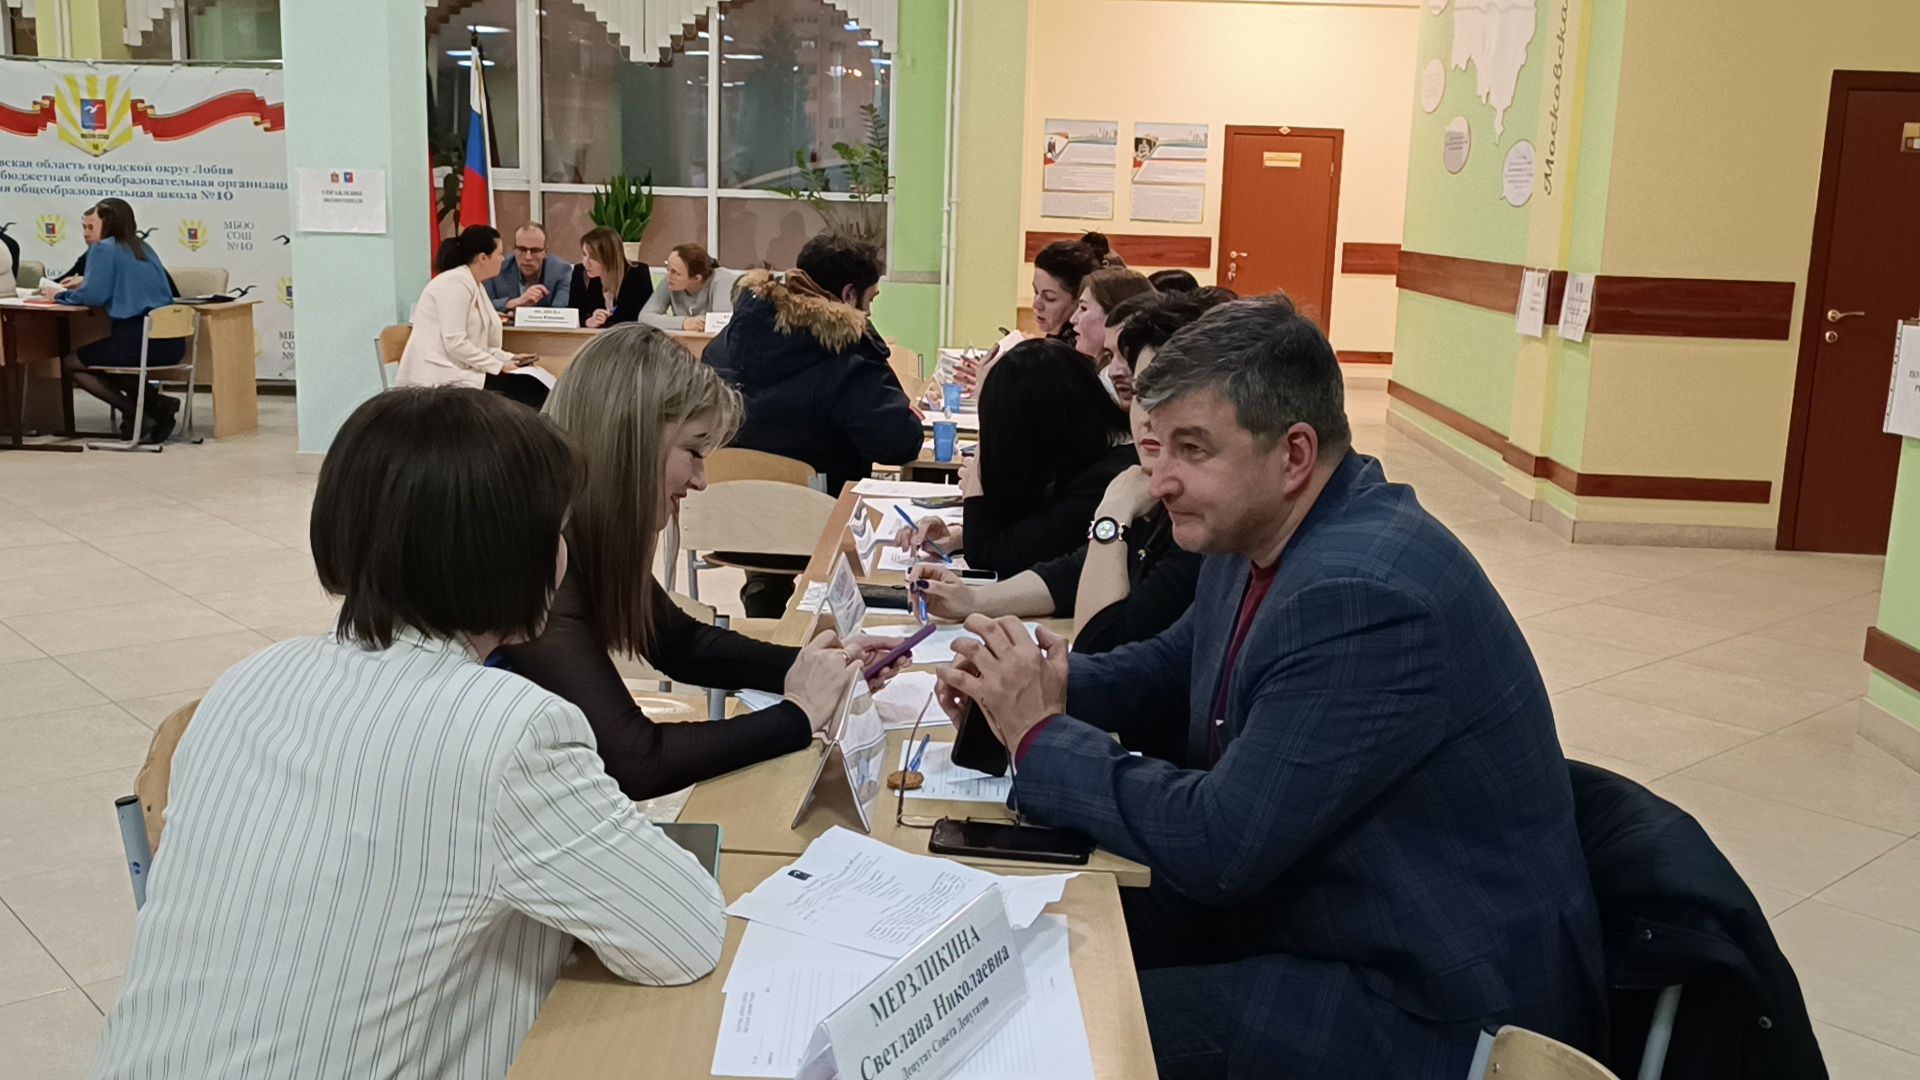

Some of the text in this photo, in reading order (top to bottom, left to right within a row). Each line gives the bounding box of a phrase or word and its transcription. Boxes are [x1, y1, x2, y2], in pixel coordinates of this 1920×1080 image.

[36, 160, 85, 171] область
[87, 162, 152, 174] городской
[155, 165, 189, 176] округ
[193, 164, 234, 176] Лобня
[74, 173, 215, 188] общеобразовательная
[13, 183, 154, 199] общеобразовательная
[157, 190, 198, 200] школа
[226, 231, 252, 241] СОШ
[869, 924, 981, 1027] МЕРЗЛИКИНА
[860, 944, 1011, 1080] Светлана Николаевна
[901, 1049, 932, 1080] Депутат
[932, 1026, 957, 1053] Совета
